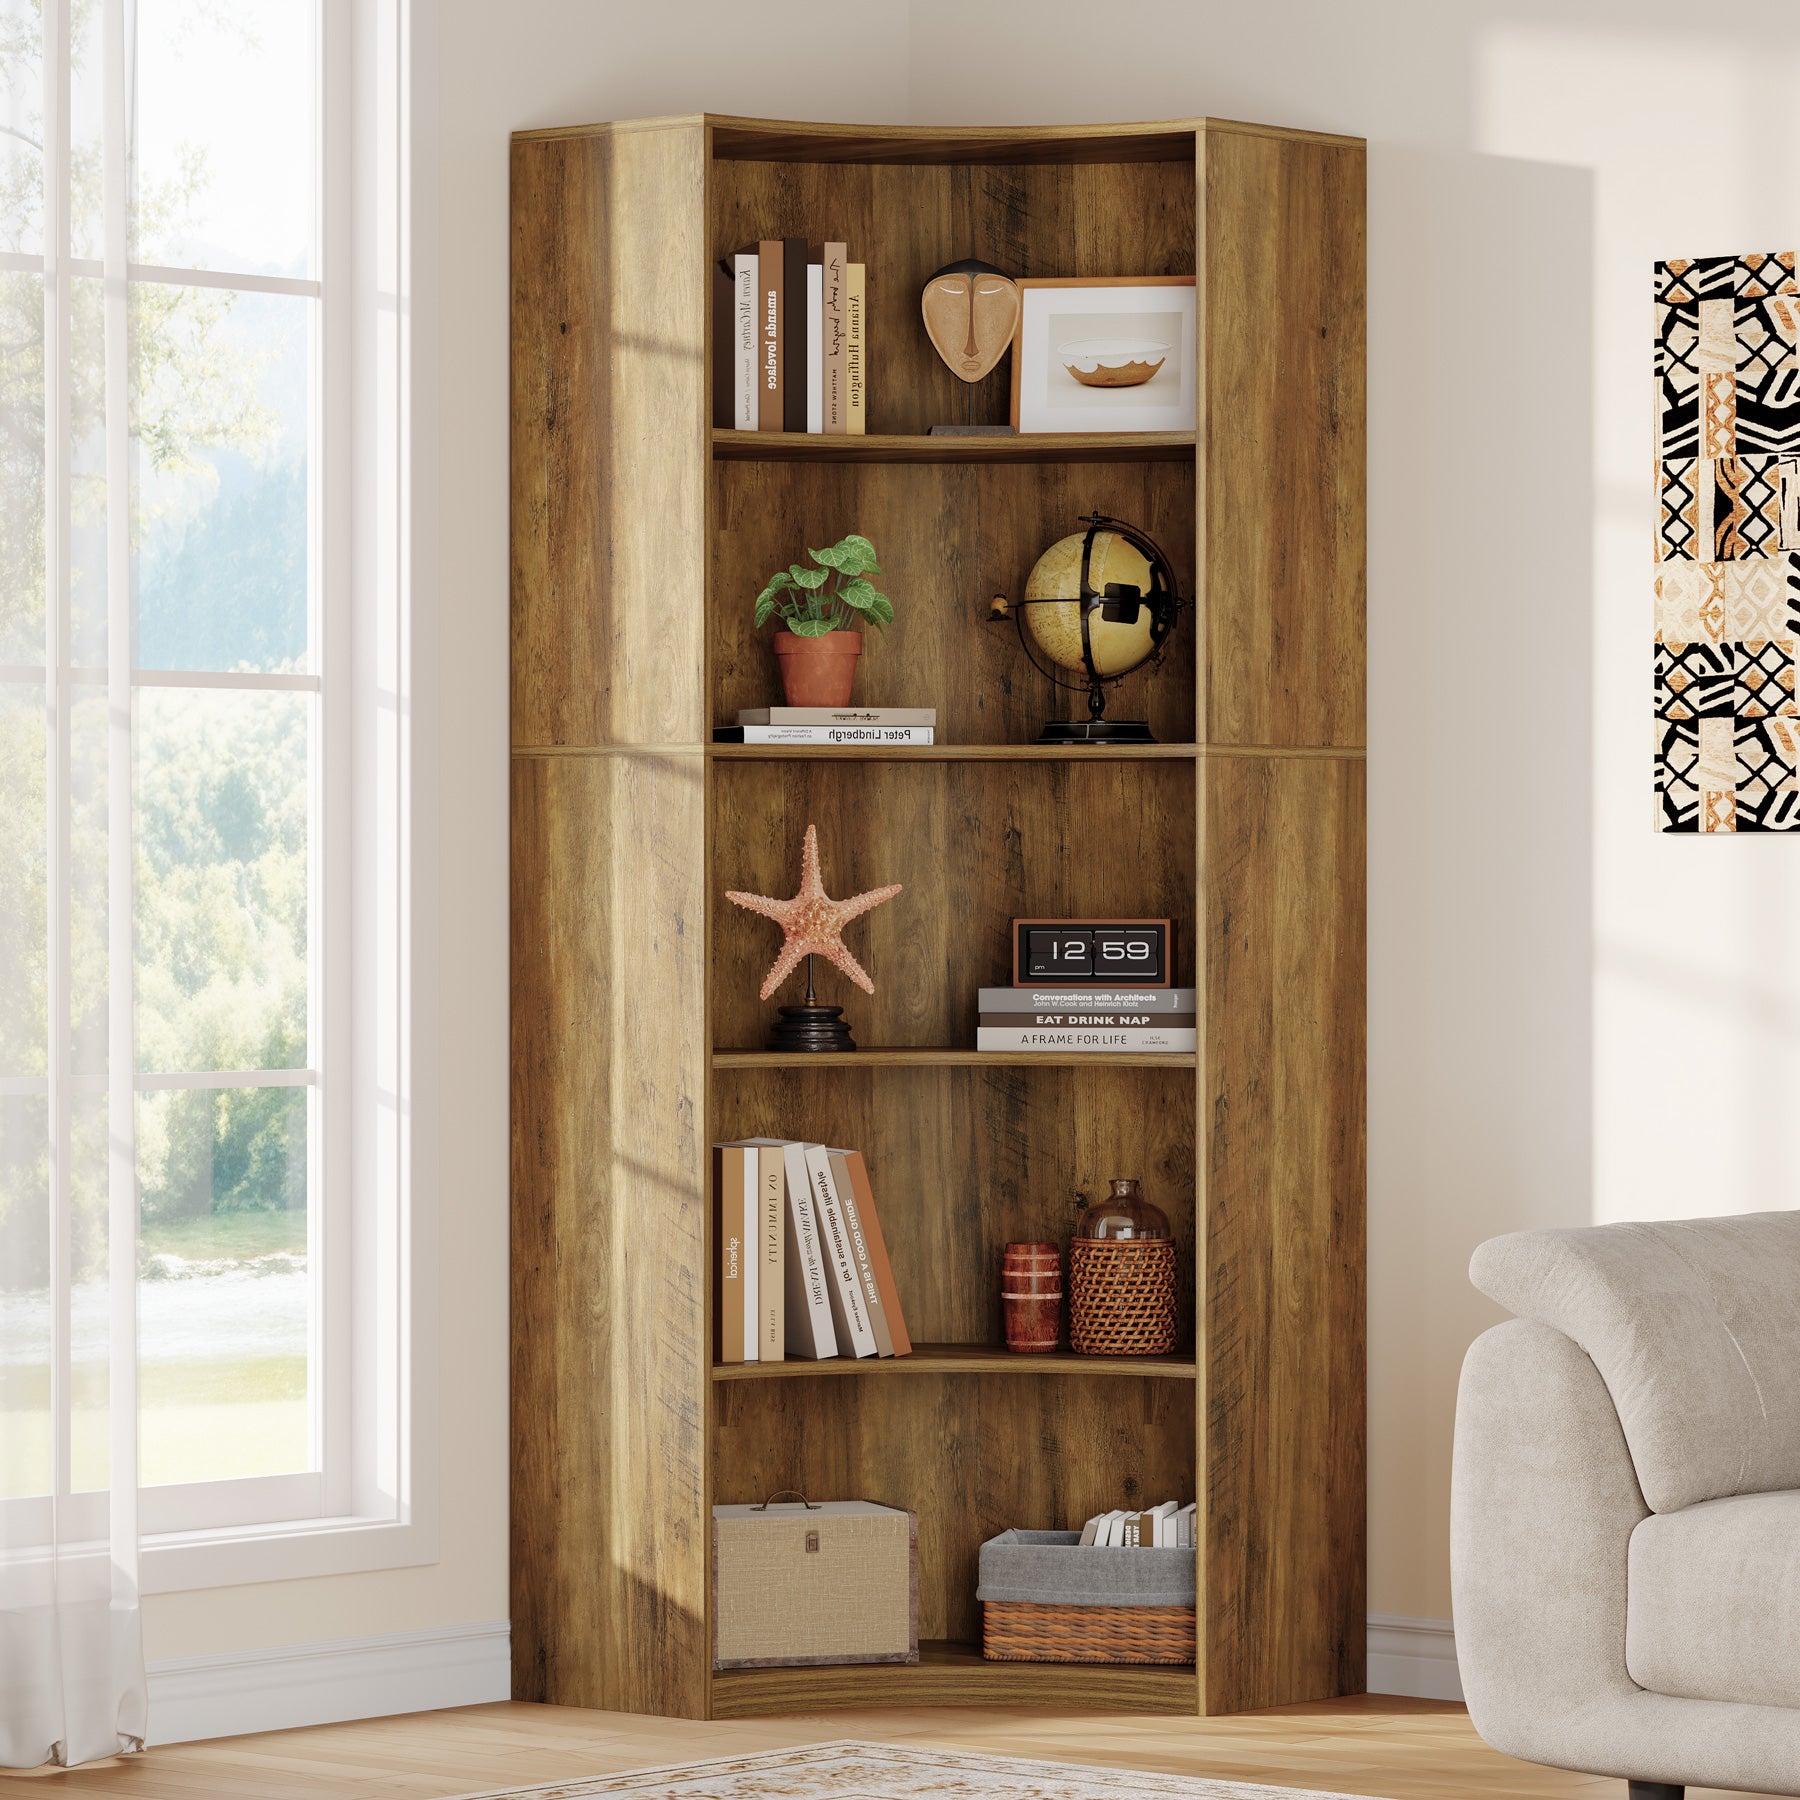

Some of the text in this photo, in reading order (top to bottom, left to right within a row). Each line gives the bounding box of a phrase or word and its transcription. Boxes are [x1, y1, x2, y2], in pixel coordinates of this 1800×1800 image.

[1053, 941, 1149, 960] 12 59
[1069, 1016, 1114, 1024] DRINK
[1120, 1016, 1150, 1024] NAP
[1021, 1035, 1127, 1044] A FRAME FOR LIFE
